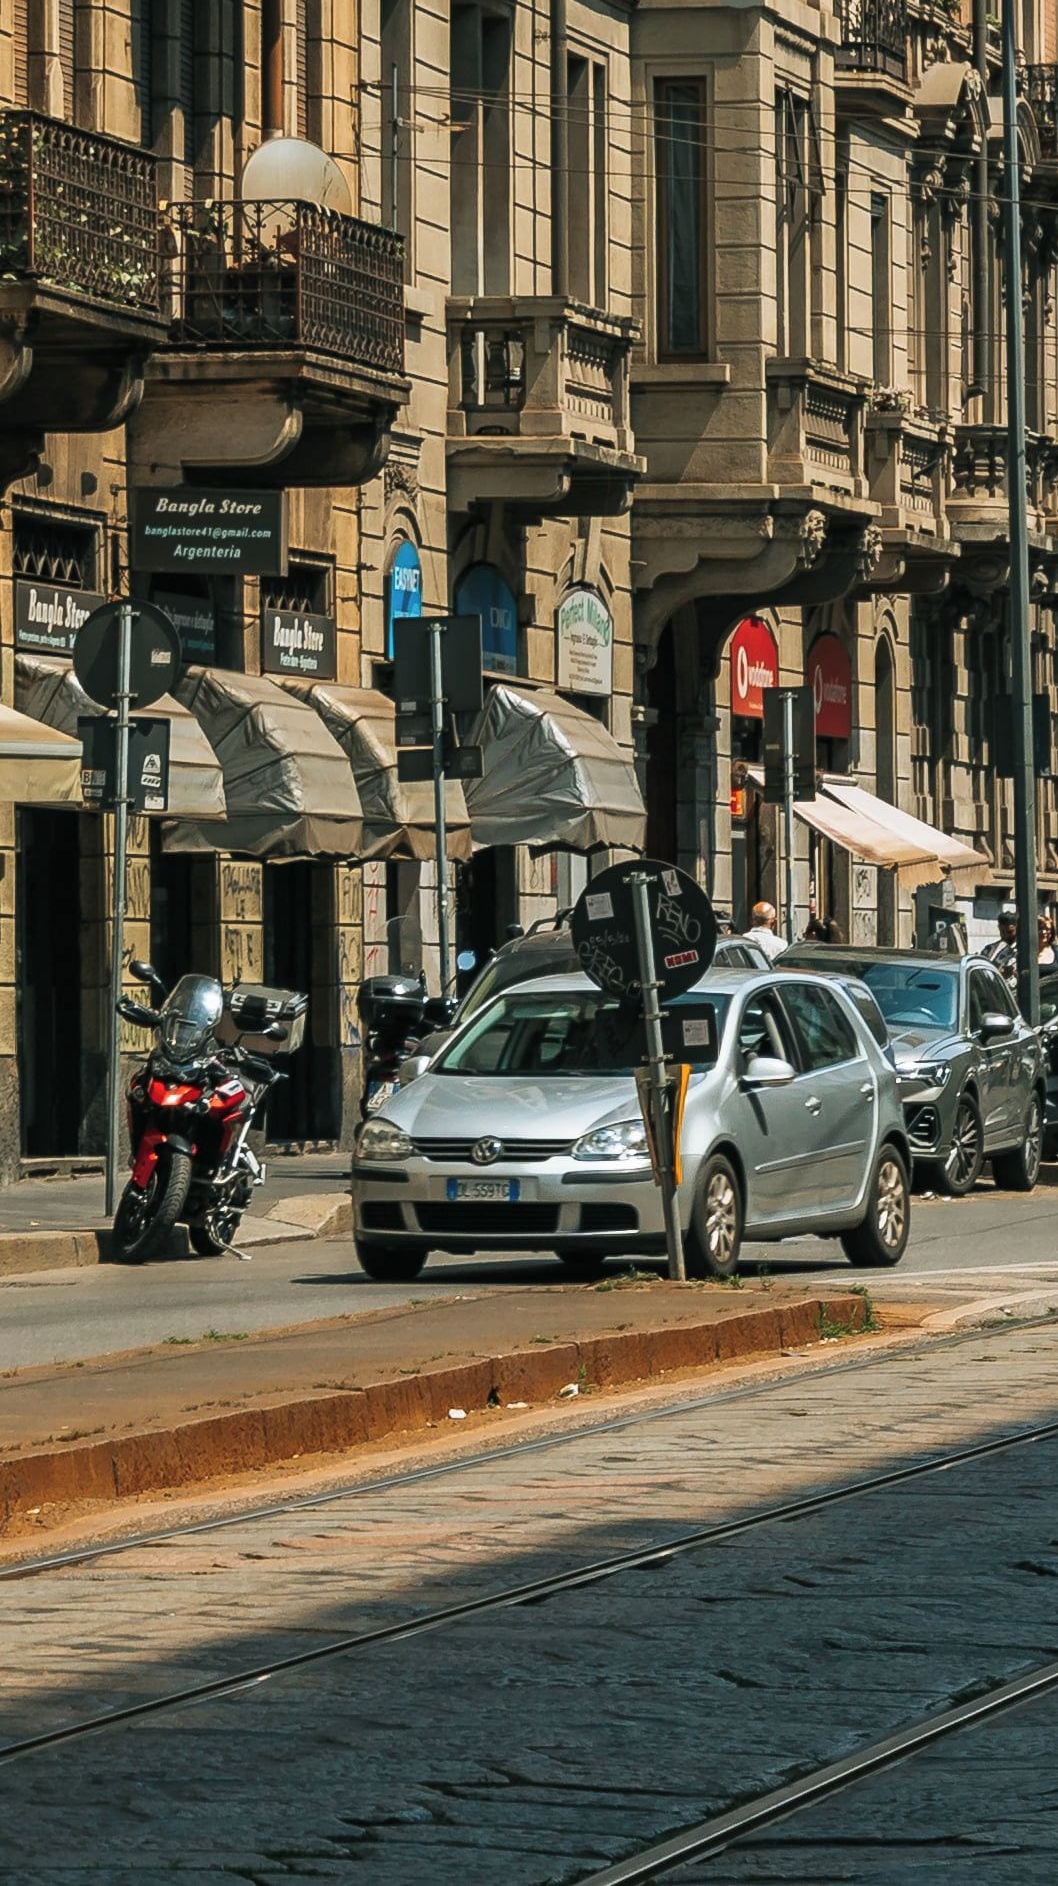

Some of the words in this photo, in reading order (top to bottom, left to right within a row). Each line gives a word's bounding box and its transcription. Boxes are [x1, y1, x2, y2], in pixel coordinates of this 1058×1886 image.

[155, 497, 214, 516] Bangla
[219, 499, 262, 514] Store
[144, 525, 271, 539] banglastore41@gmail.com
[173, 543, 241, 560] Argenteria
[28, 589, 63, 633] Bangla
[273, 616, 303, 655] Bangla
[303, 620, 324, 652] Store
[749, 662, 774, 688] vodafone
[823, 676, 848, 704] vodafone
